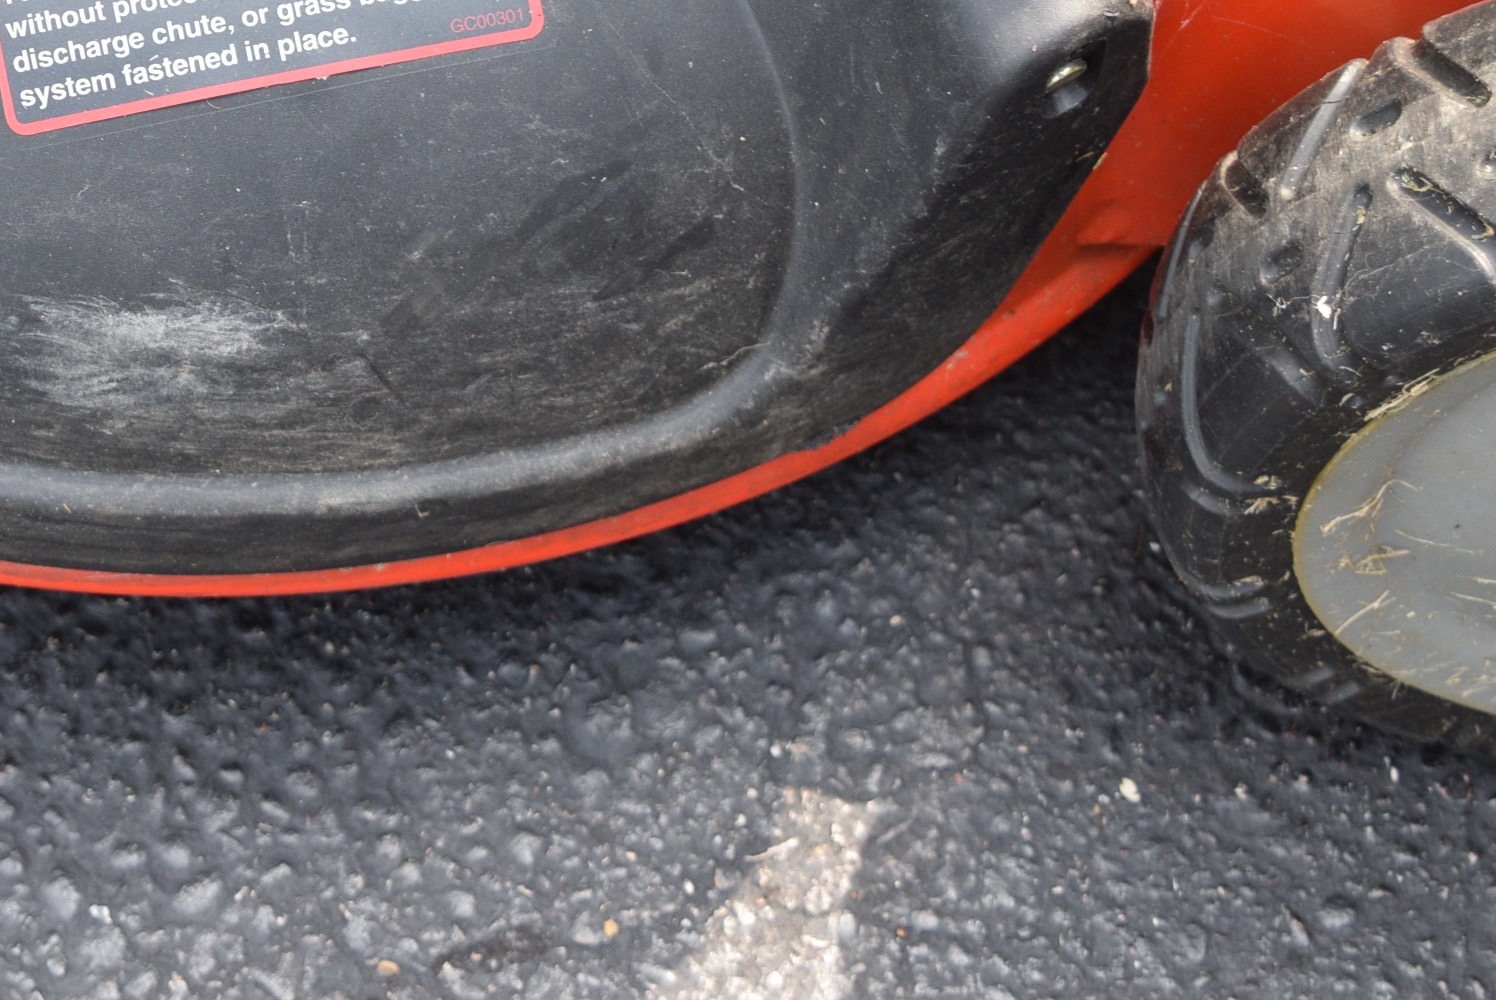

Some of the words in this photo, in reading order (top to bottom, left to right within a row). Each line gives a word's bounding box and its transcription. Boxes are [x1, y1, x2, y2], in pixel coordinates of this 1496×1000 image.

[5, 1, 106, 39] without
[12, 31, 144, 73] discharge
[152, 14, 235, 45] chute,
[242, 6, 269, 27] or
[450, 8, 524, 33] GC00301
[19, 71, 116, 109] system
[122, 43, 238, 86] fastened
[245, 40, 269, 62] in
[277, 27, 357, 61] place.
